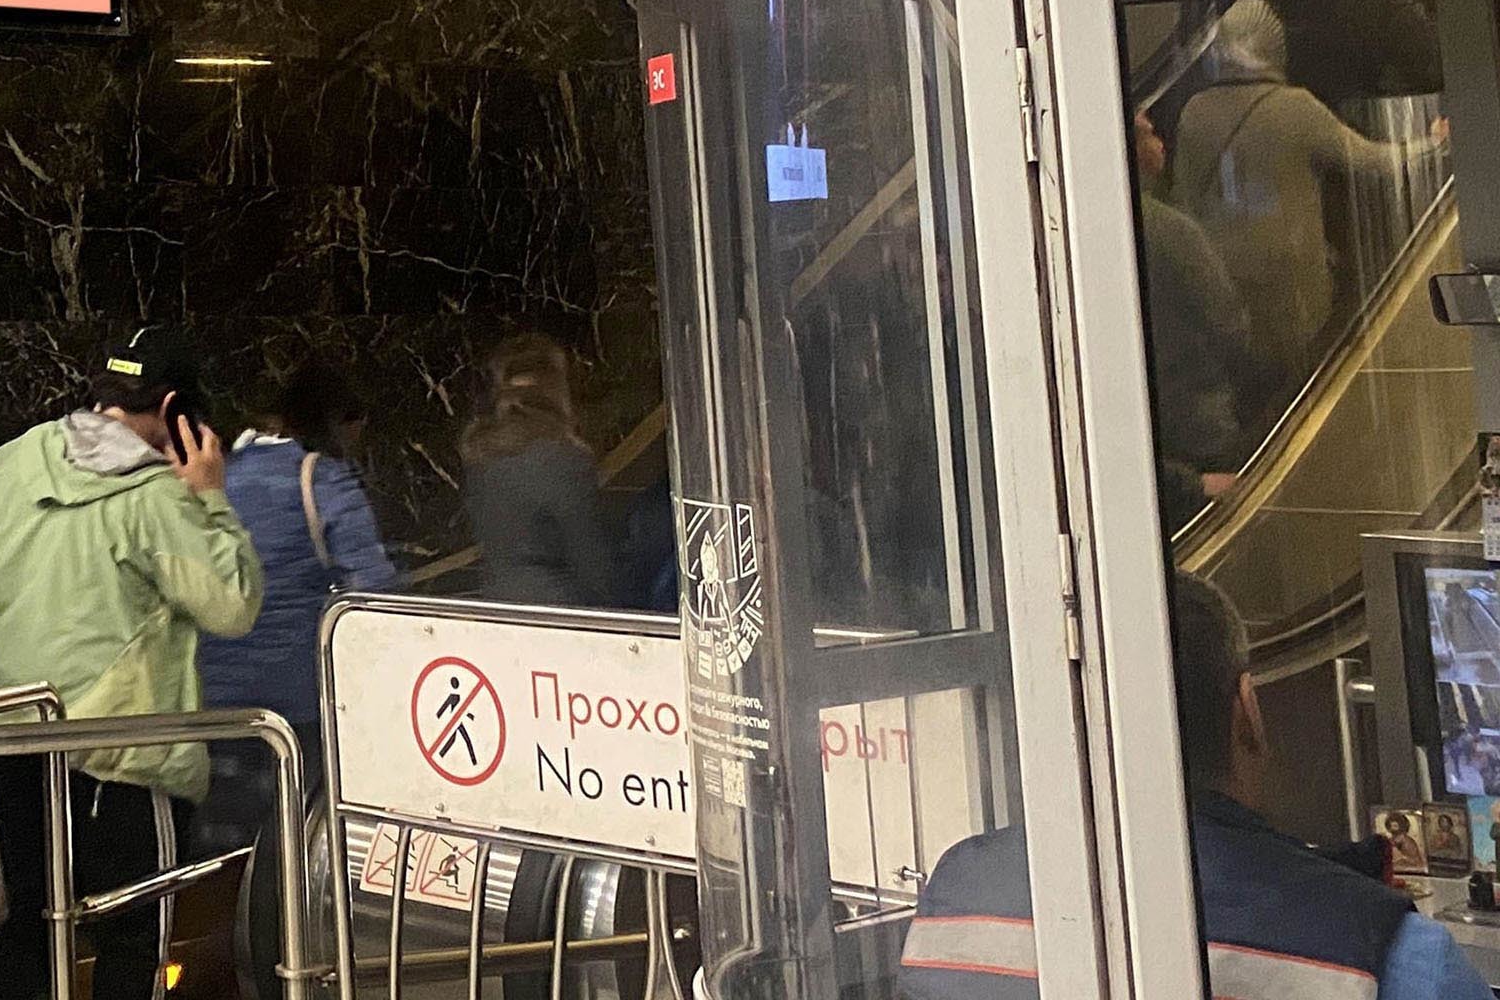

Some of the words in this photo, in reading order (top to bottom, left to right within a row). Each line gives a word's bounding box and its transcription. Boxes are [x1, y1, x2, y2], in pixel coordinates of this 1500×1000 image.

[531, 670, 689, 746] Прохо
[820, 720, 914, 773] рыт
[536, 742, 603, 800] No
[622, 769, 689, 813] ent
